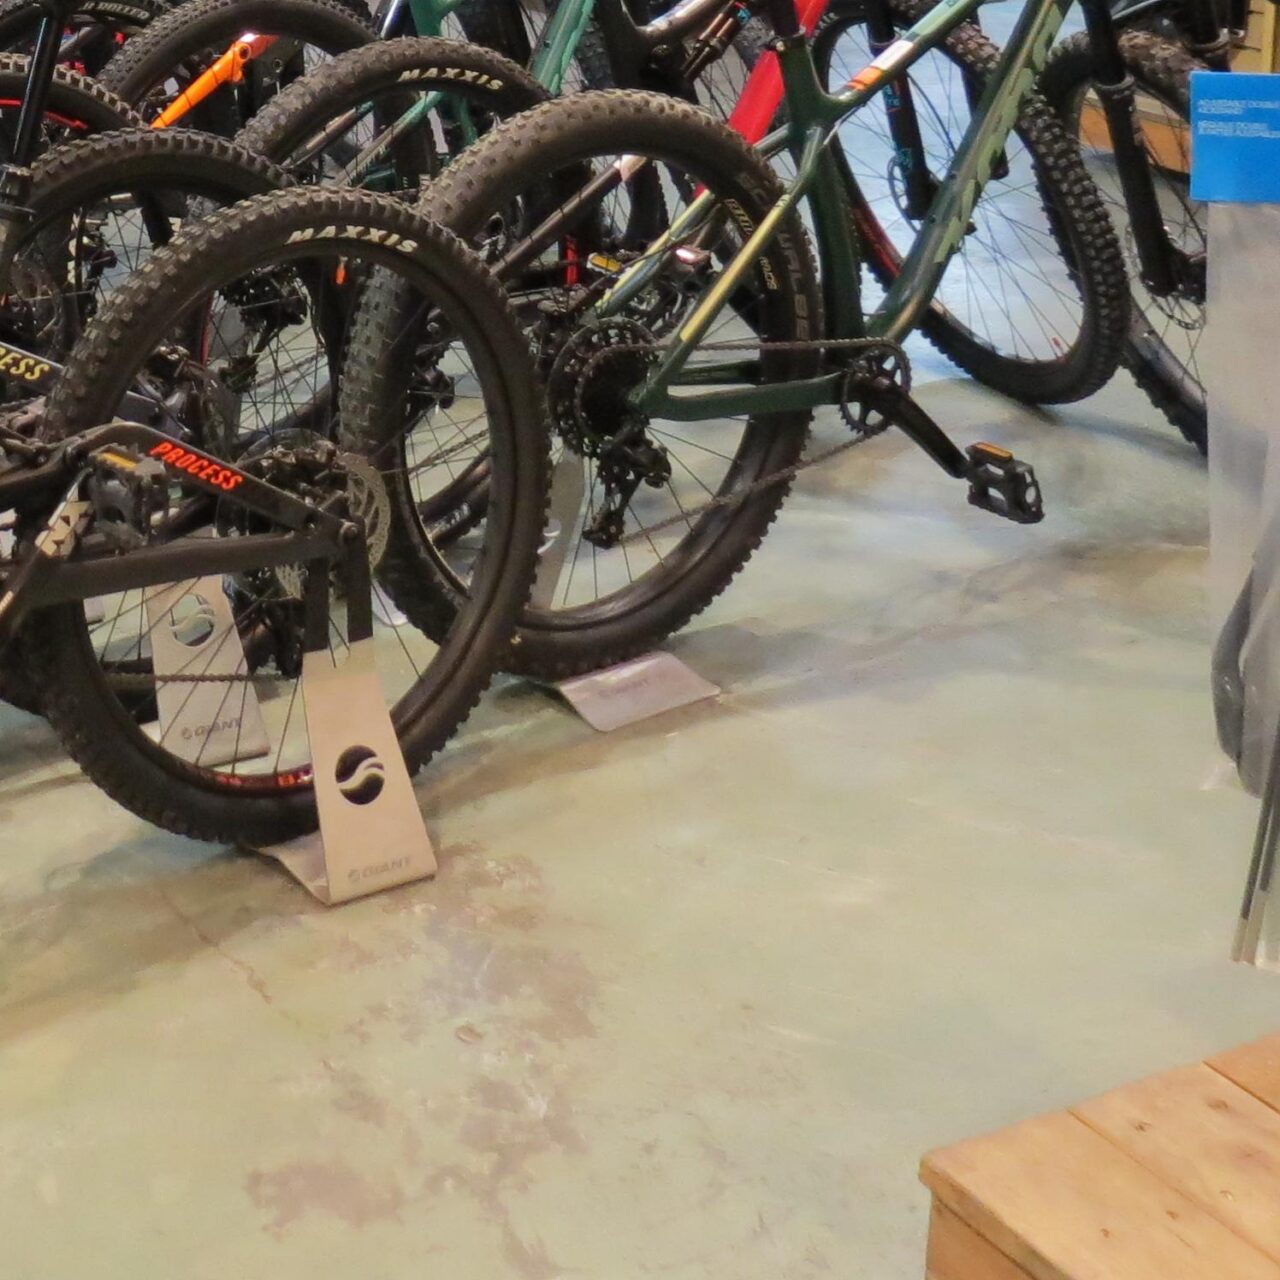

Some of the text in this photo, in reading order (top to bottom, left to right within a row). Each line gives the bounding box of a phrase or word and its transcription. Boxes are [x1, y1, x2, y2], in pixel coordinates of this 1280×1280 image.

[397, 67, 504, 90] MAXXIS
[285, 225, 419, 254] MAXXIS
[149, 441, 243, 490] PROCESS
